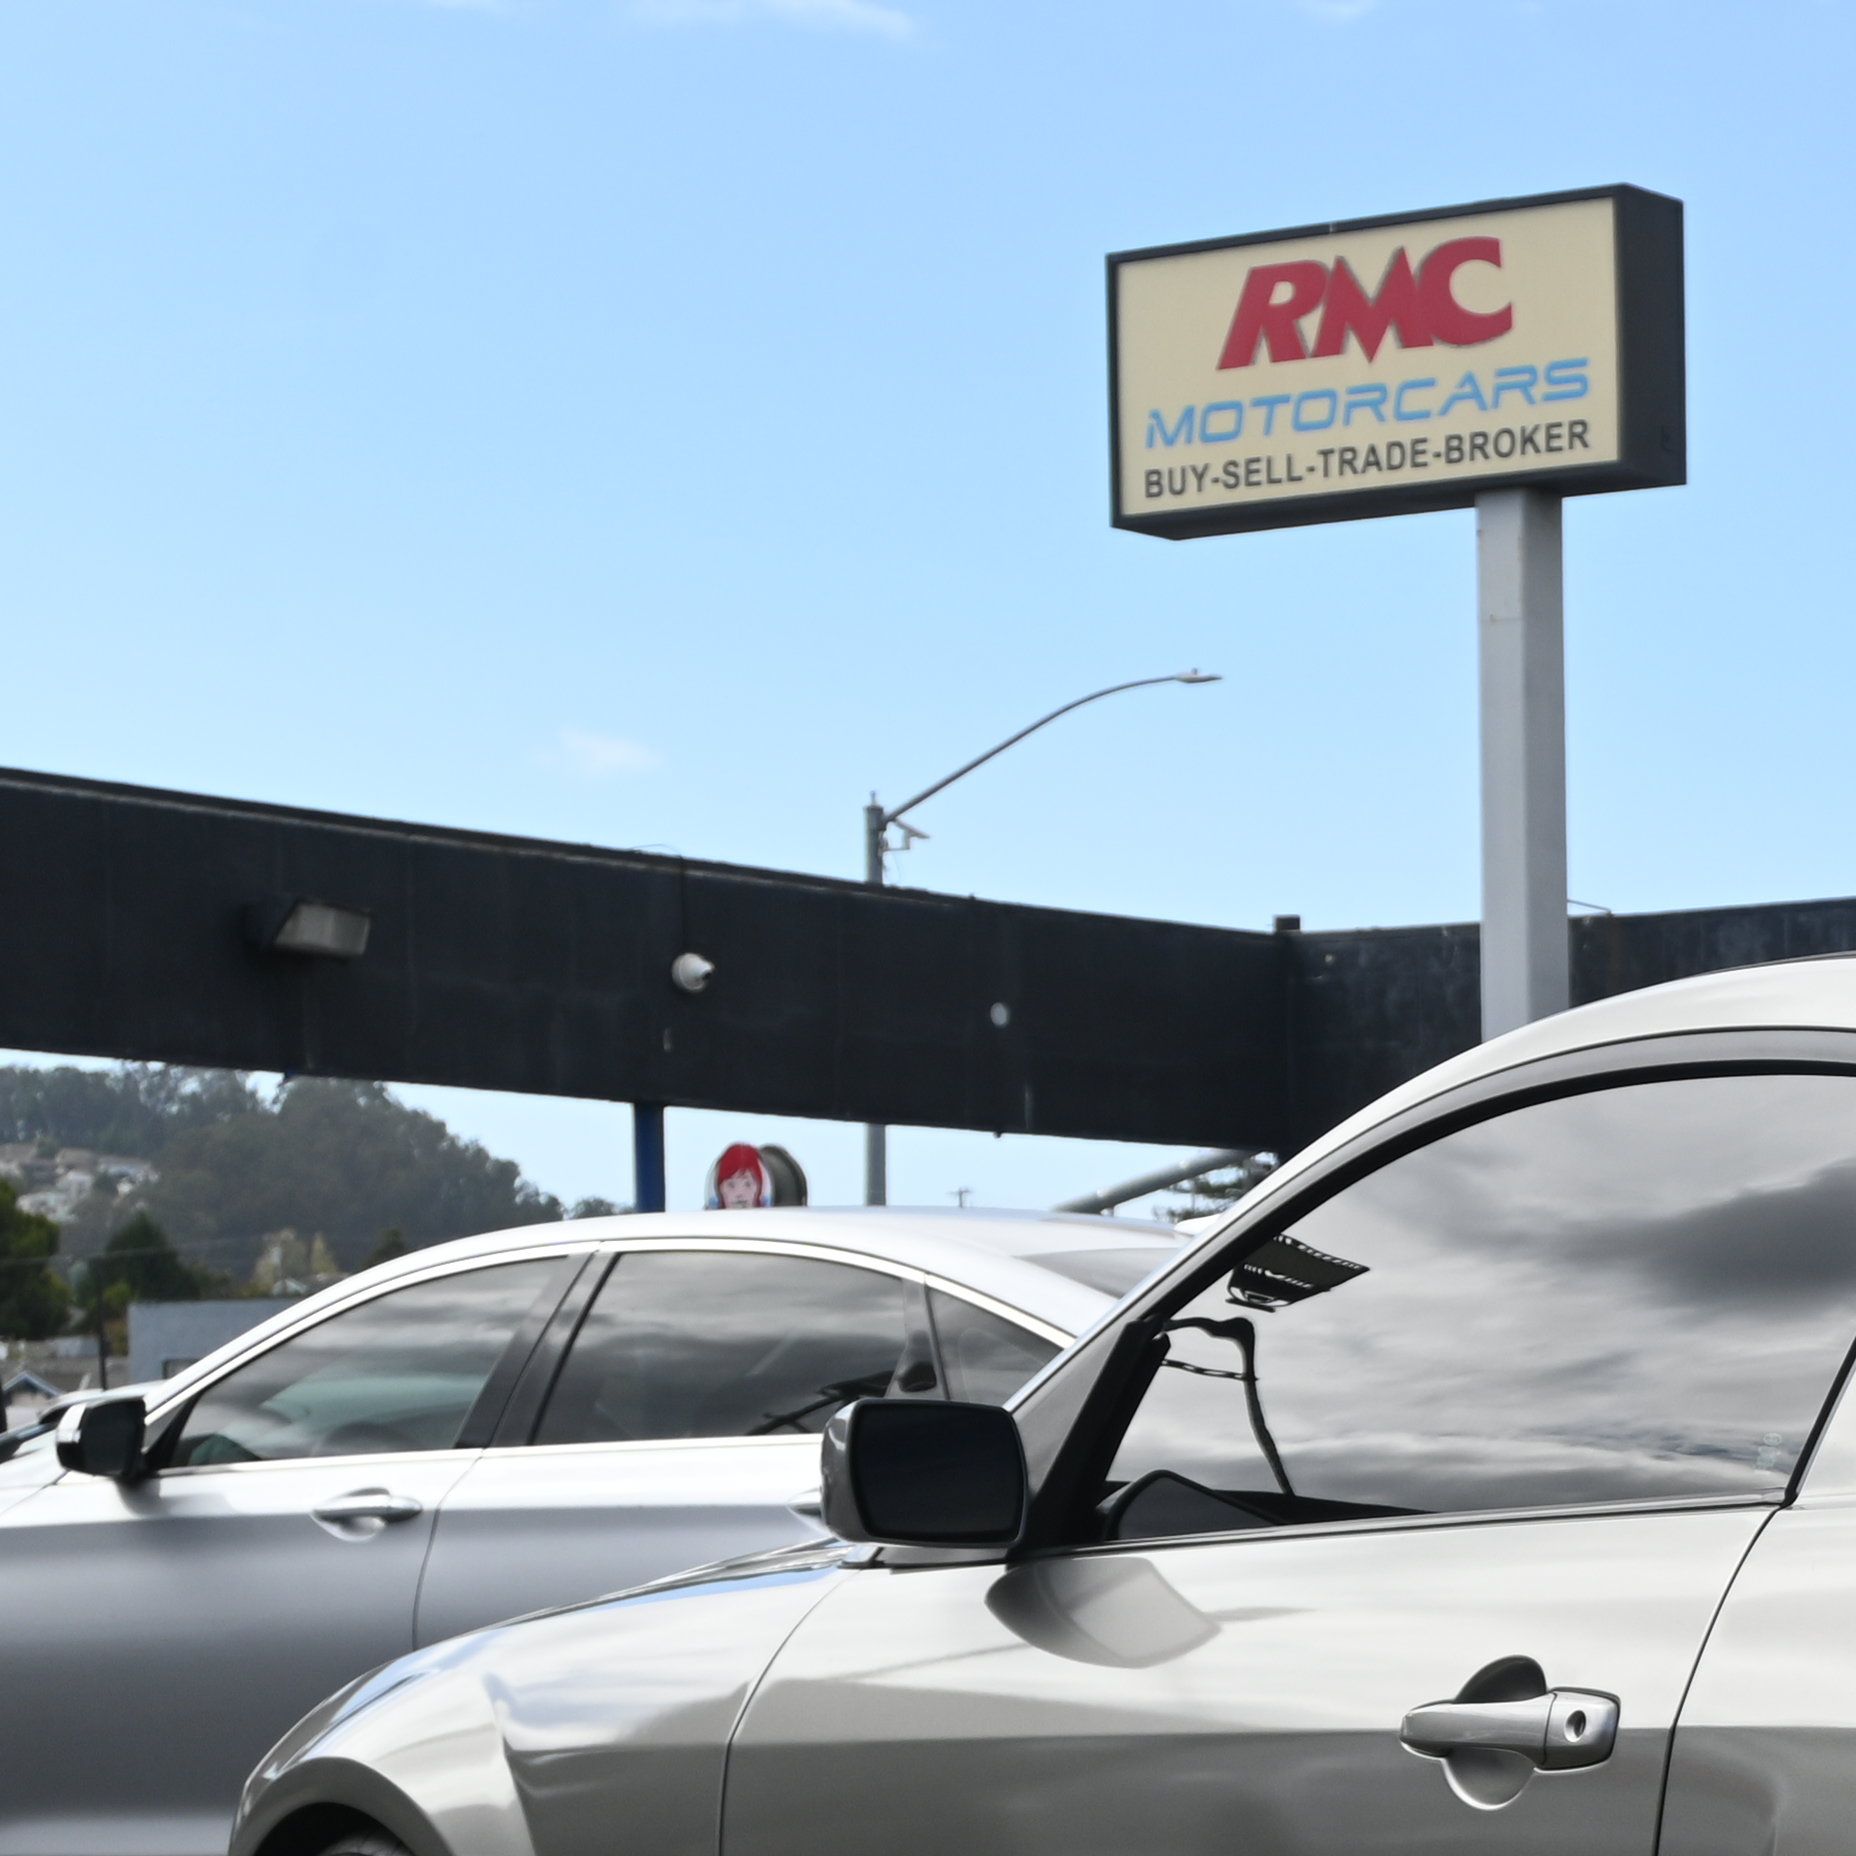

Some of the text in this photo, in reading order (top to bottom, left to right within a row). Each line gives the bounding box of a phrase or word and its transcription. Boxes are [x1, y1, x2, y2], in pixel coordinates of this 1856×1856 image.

[1217, 236, 1515, 370] RMC
[1145, 357, 1591, 449] MOTORCARS
[1144, 418, 1591, 498] BUY-SELL-TRADE-BROKER
